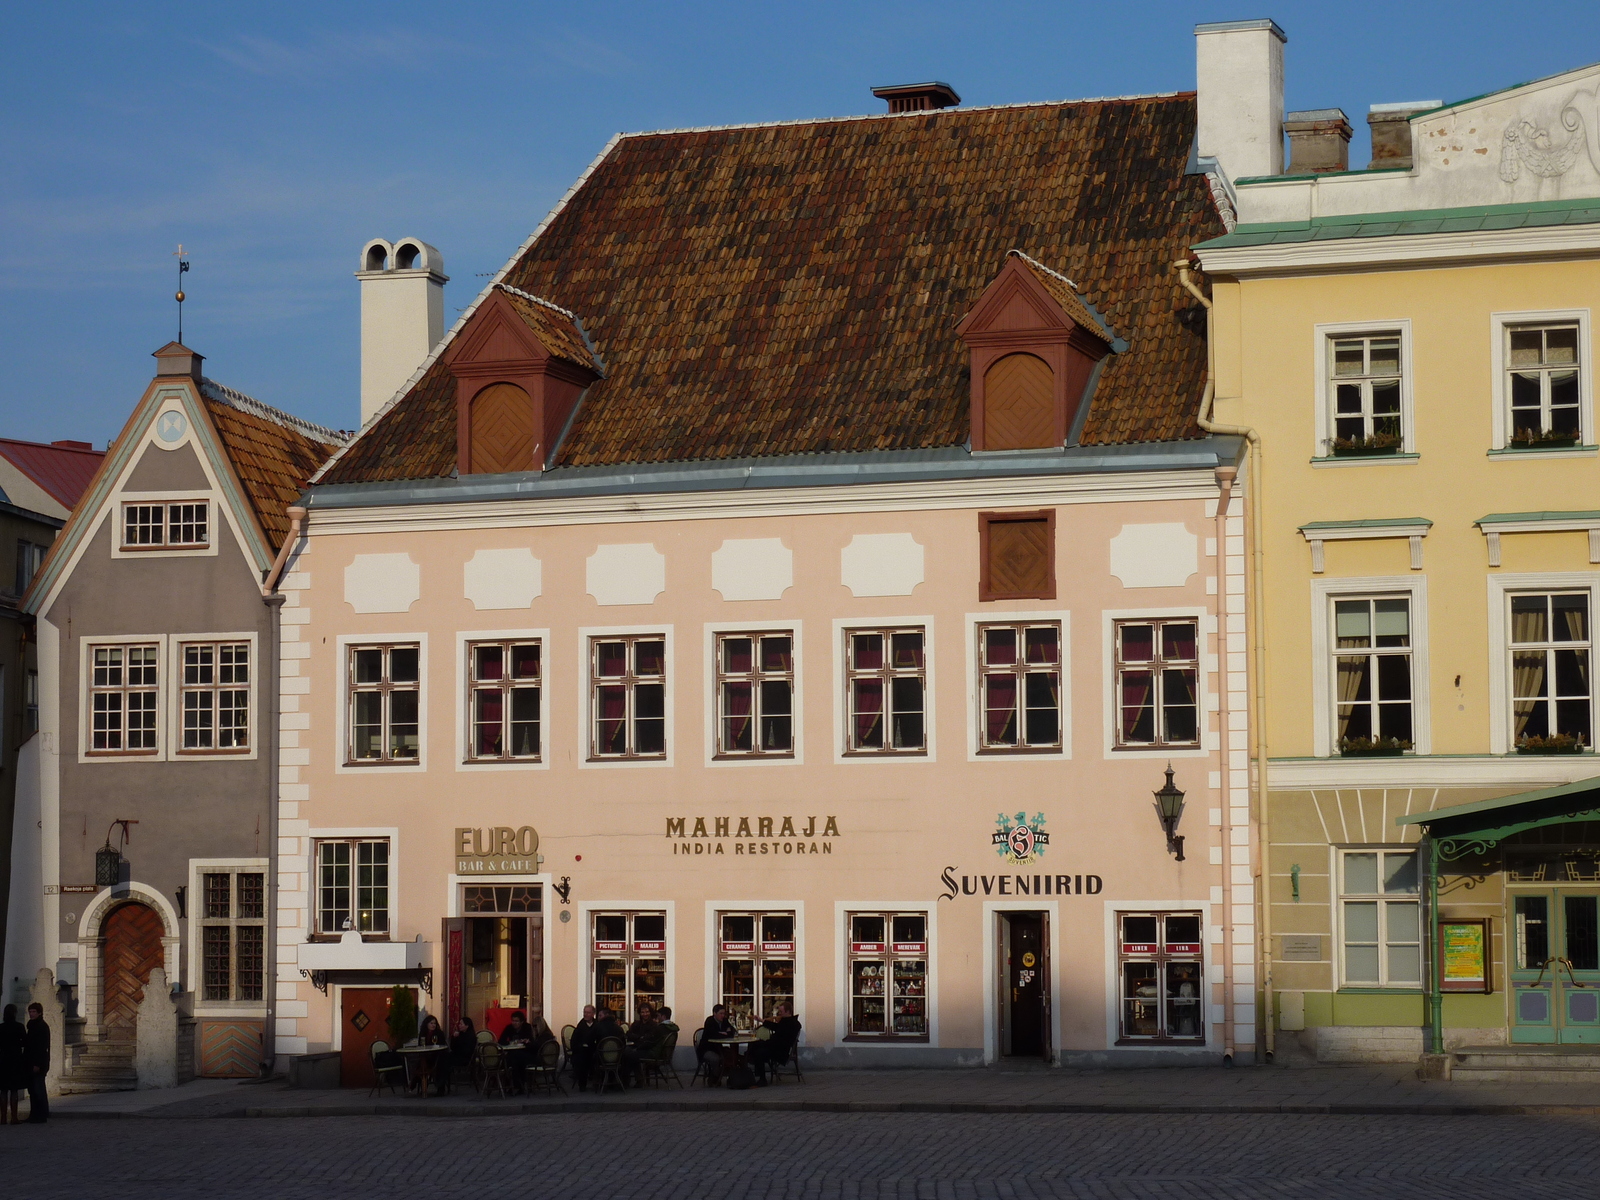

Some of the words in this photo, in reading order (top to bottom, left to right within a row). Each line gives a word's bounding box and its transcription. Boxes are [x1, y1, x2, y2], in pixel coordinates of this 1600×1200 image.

[665, 815, 841, 838] MAHARAJA
[455, 825, 539, 857] EURO
[673, 842, 725, 855] INDIA
[735, 842, 832, 855] RESTORAN
[459, 860, 484, 871] BAR
[488, 860, 497, 871] &
[501, 860, 533, 871] CAFE
[937, 866, 1103, 902] SUVENIIRID
